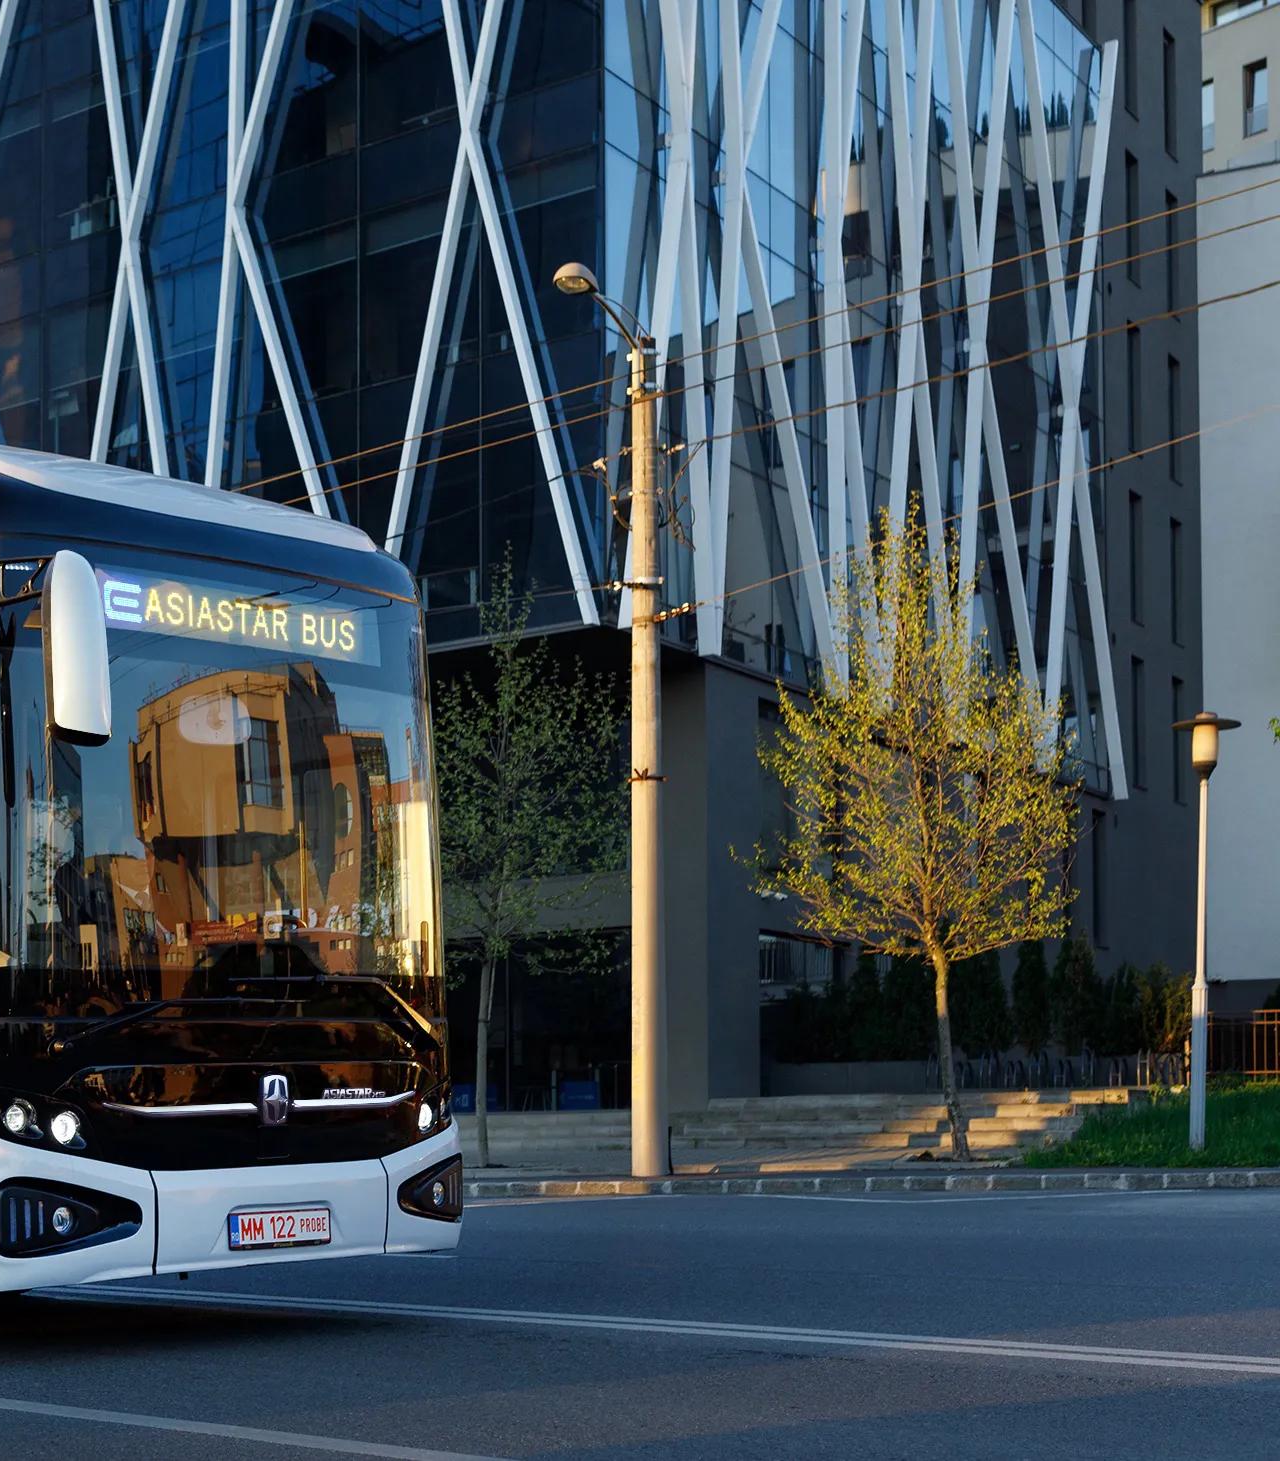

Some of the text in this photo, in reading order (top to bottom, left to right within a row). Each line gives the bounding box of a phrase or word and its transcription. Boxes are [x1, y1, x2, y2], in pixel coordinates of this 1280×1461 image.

[144, 588, 288, 642] ASIASTAR
[302, 613, 356, 651] BUS
[322, 1087, 373, 1100] ASIASTAR
[240, 1215, 327, 1241] MM 122 PROBE
